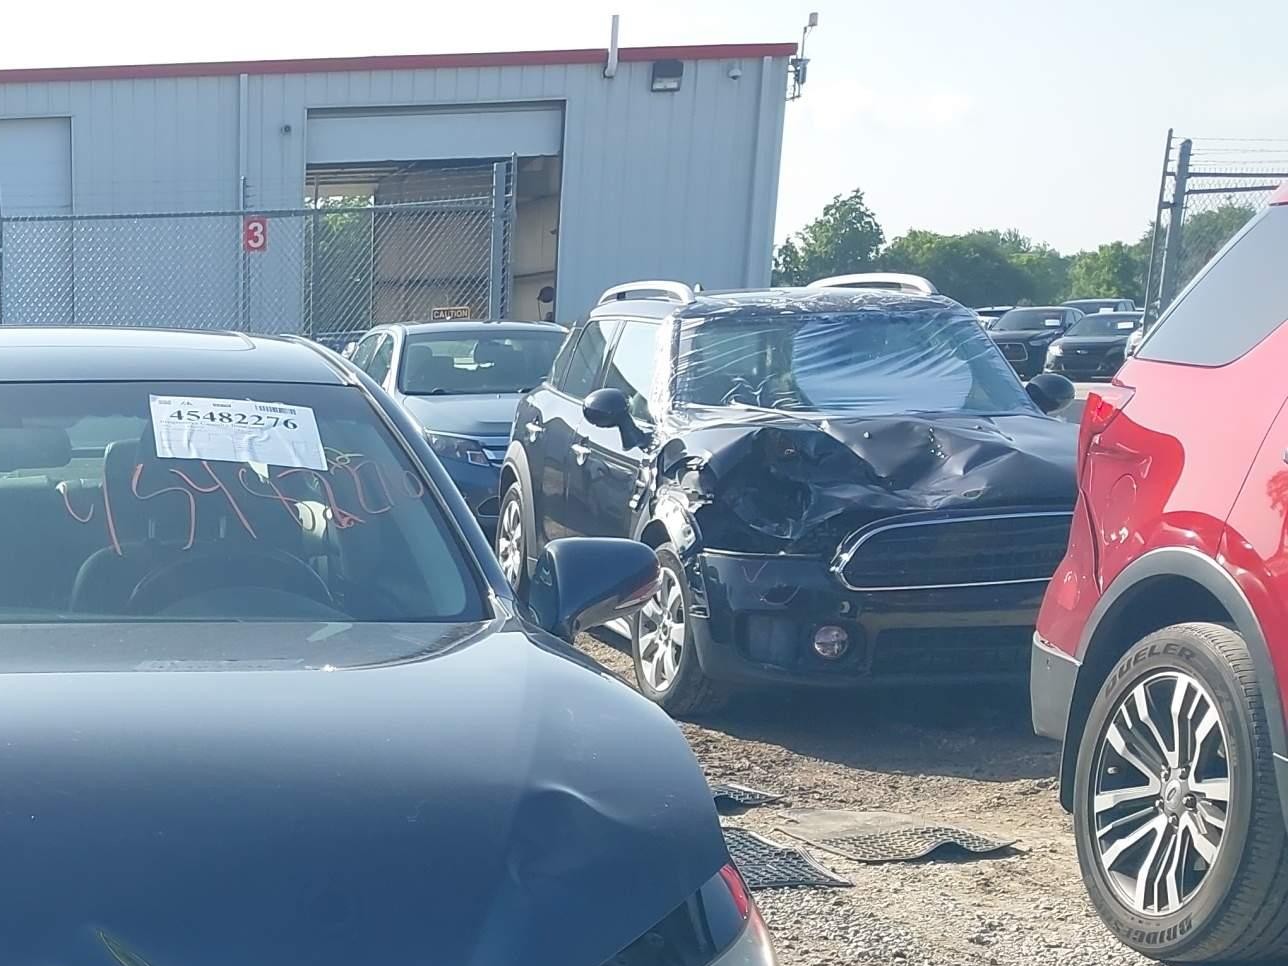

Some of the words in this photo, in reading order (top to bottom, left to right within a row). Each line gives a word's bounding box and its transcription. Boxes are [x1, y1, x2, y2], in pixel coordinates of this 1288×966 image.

[247, 222, 265, 248] 3
[433, 309, 468, 319] CAUTION
[169, 409, 298, 430] 45482276
